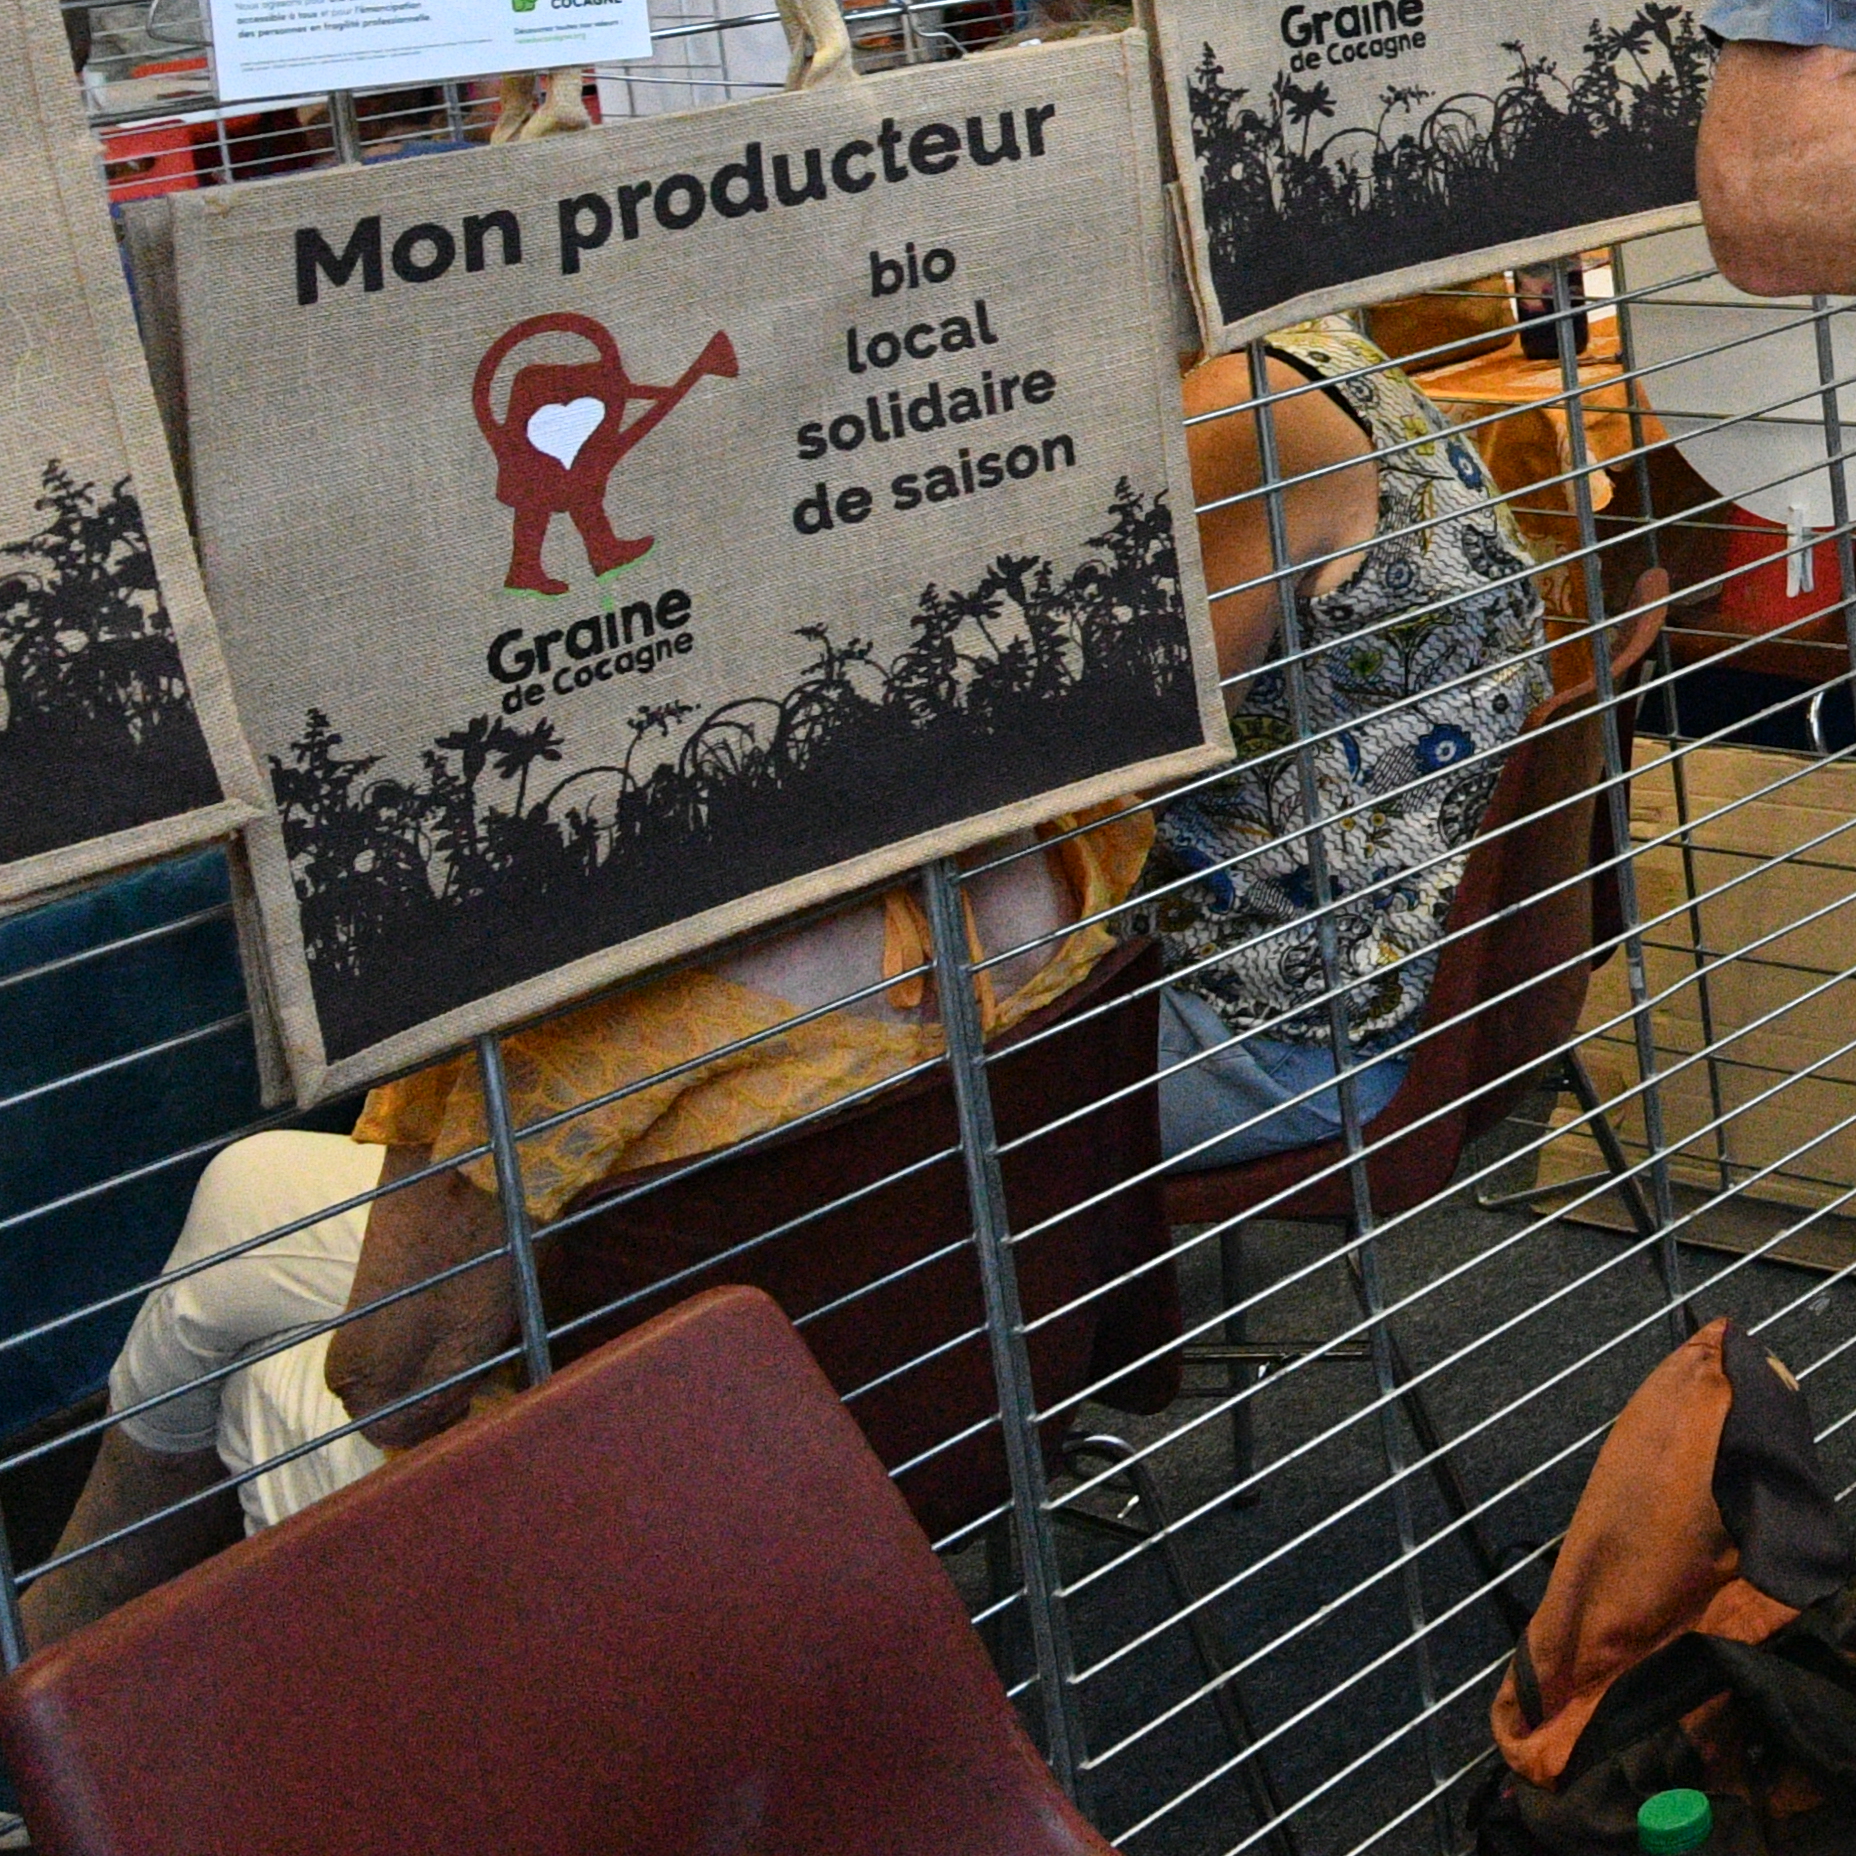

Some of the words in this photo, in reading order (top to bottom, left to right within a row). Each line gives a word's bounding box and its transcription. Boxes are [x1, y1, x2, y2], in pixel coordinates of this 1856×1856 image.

[1289, 47, 1321, 74] de
[1326, 28, 1426, 67] Cocagne
[295, 200, 545, 305] Mon
[559, 98, 1056, 275] producteur
[869, 241, 956, 297] bio
[846, 300, 997, 375] local
[797, 364, 1056, 459] solidaire
[792, 479, 873, 536] de
[892, 431, 1076, 512] saison
[487, 587, 692, 686] Graine
[502, 680, 545, 715] de
[553, 628, 694, 699] Cocagne
